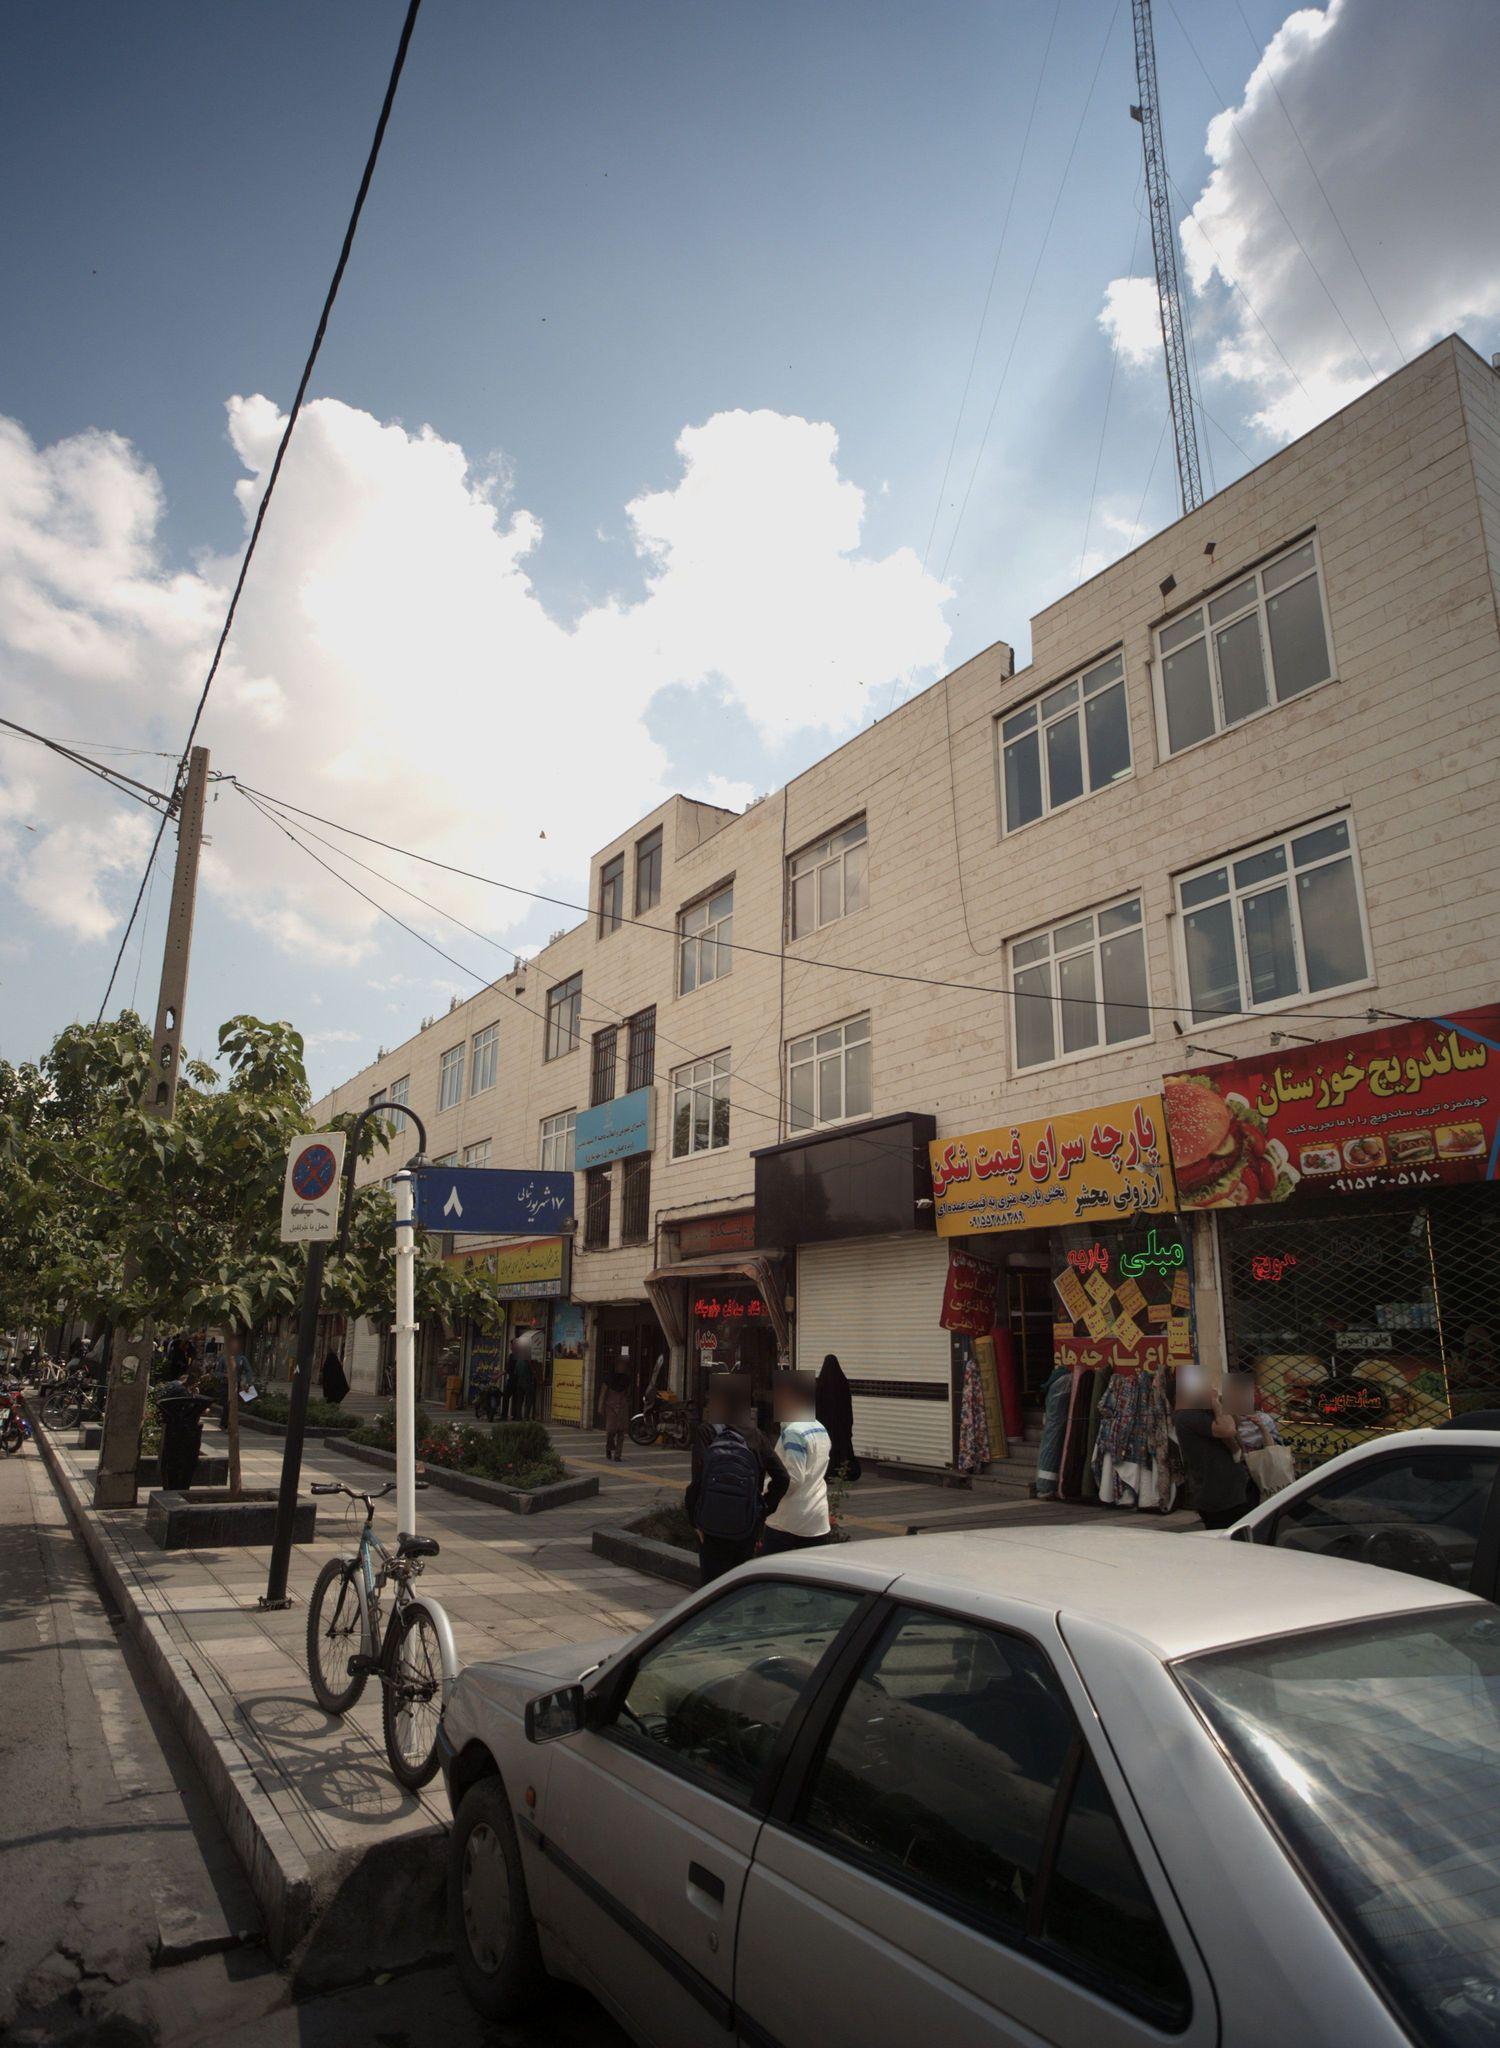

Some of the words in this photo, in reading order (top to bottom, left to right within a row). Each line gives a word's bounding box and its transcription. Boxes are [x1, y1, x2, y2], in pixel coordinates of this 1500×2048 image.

[1368, 1029, 1488, 1097] ساندویچ
[1256, 1050, 1366, 1117] خوزستان
[1369, 1106, 1412, 1126] ساندویچ
[1414, 1101, 1441, 1118] ترین
[1443, 1095, 1488, 1112] خوشمزه
[1089, 1103, 1161, 1173] پارچه
[1286, 1123, 1306, 1136] کنید
[1308, 1119, 1334, 1133] تجربه
[974, 1127, 1024, 1184] قیمت
[1028, 1121, 1085, 1181] سرای
[931, 1144, 972, 1197] شکن
[1329, 1170, 1441, 1193] ۰۹۱۵۳۰۰۵۱۸۰
[443, 1185, 464, 1218] ۸
[517, 1181, 535, 1202] شمالی
[525, 1186, 551, 1223] شهریور
[551, 1196, 565, 1211] ۱۷
[967, 1196, 987, 1212] قیمت
[1018, 1188, 1042, 1208] پارچه
[1043, 1184, 1067, 1204] پخش
[1073, 1182, 1110, 1216] محشر
[1113, 1172, 1163, 1211] ارزونی
[315, 1222, 329, 1232] حمل
[1067, 1242, 1109, 1274] پارچه
[1119, 1229, 1185, 1278] مبلی
